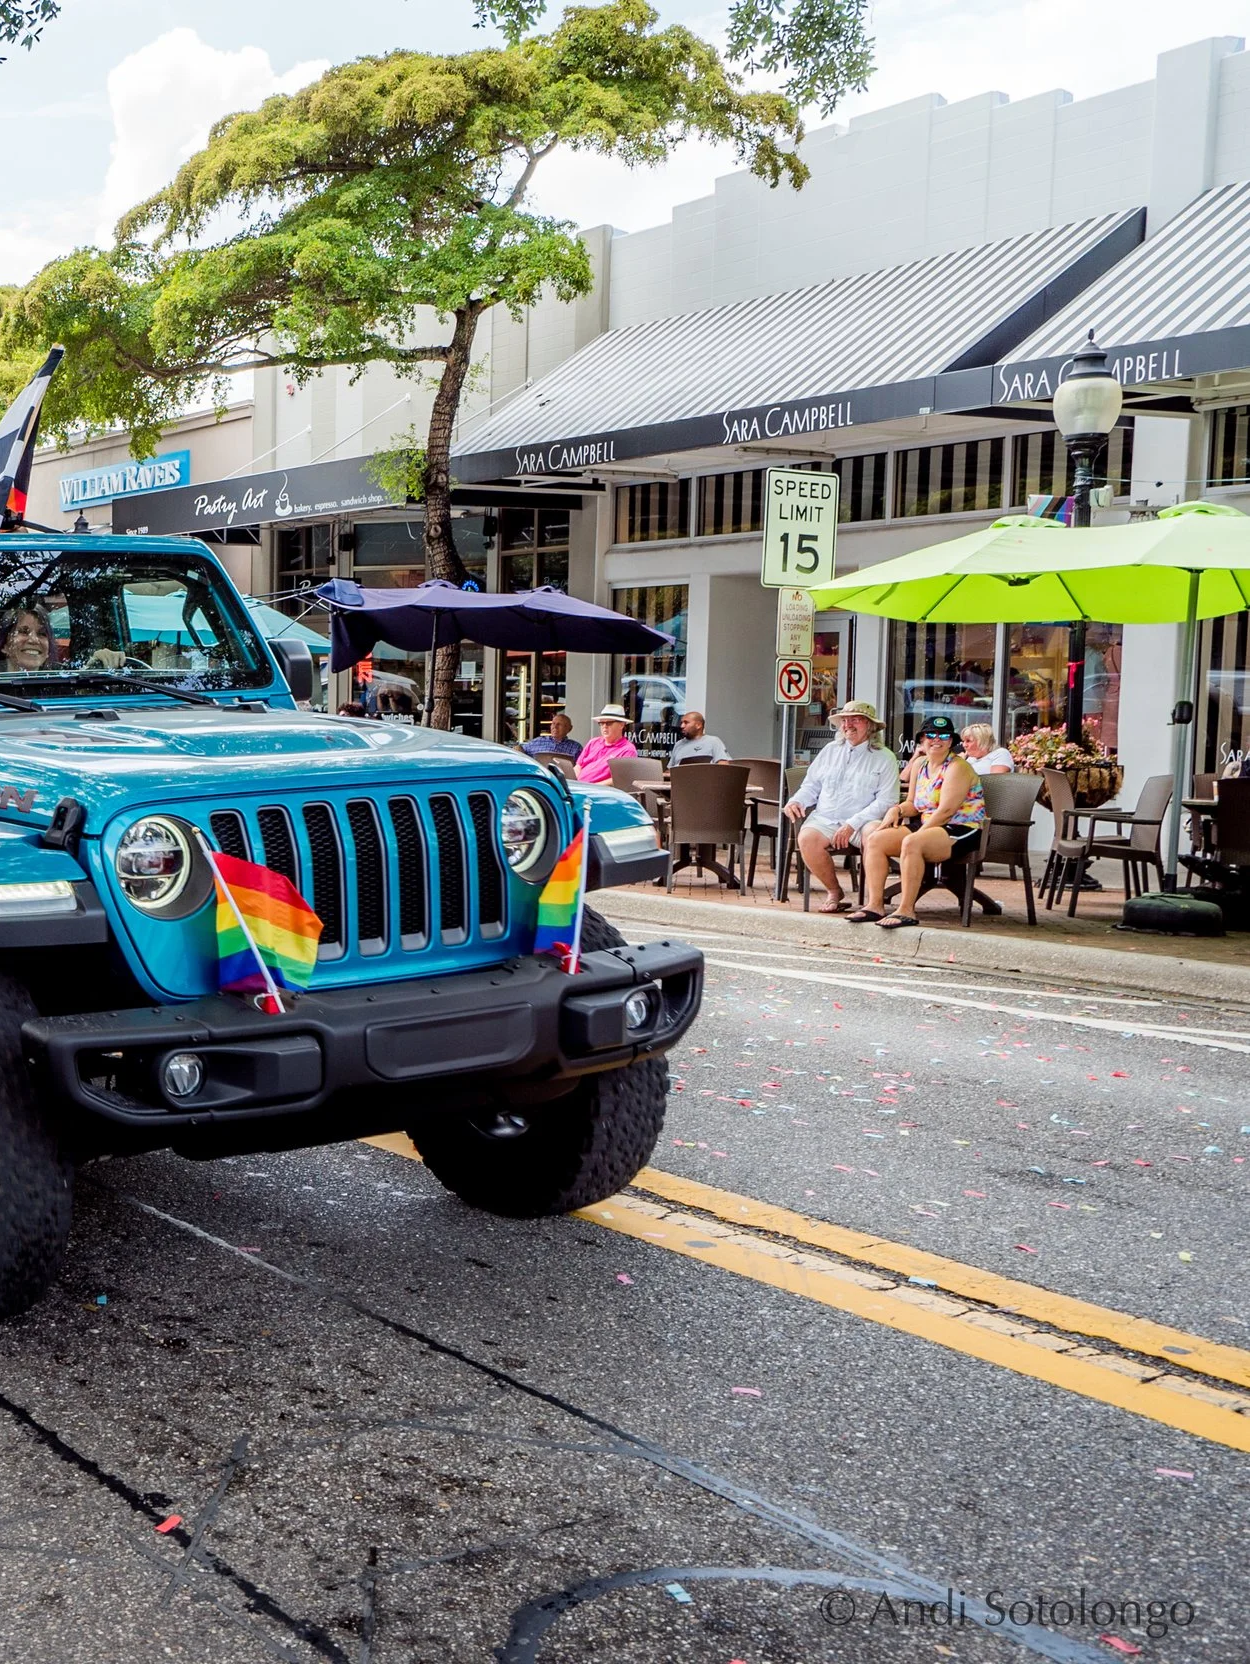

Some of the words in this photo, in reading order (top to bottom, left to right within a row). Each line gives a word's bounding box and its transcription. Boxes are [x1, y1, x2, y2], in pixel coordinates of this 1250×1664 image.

[998, 364, 1052, 403] SARA
[1058, 349, 1183, 386] CPBELL
[722, 411, 761, 444] SARA
[765, 401, 854, 437] CAMPBELL
[515, 446, 546, 475] SARA
[548, 440, 616, 470] CAMPBELL
[59, 471, 125, 504] WILLIAM
[773, 479, 832, 500] SPEED
[194, 494, 238, 525] Pastry
[242, 487, 268, 511] Art
[340, 494, 367, 507] sandwich
[778, 503, 824, 523] LIMIT
[779, 532, 820, 575] 15
[781, 613, 812, 623] UNLOADING
[785, 603, 809, 612] LOADING
[783, 623, 809, 632] STOPPING
[790, 633, 802, 642] ANY
[638, 729, 678, 745] CAMPBELL
[898, 732, 915, 753] SAR
